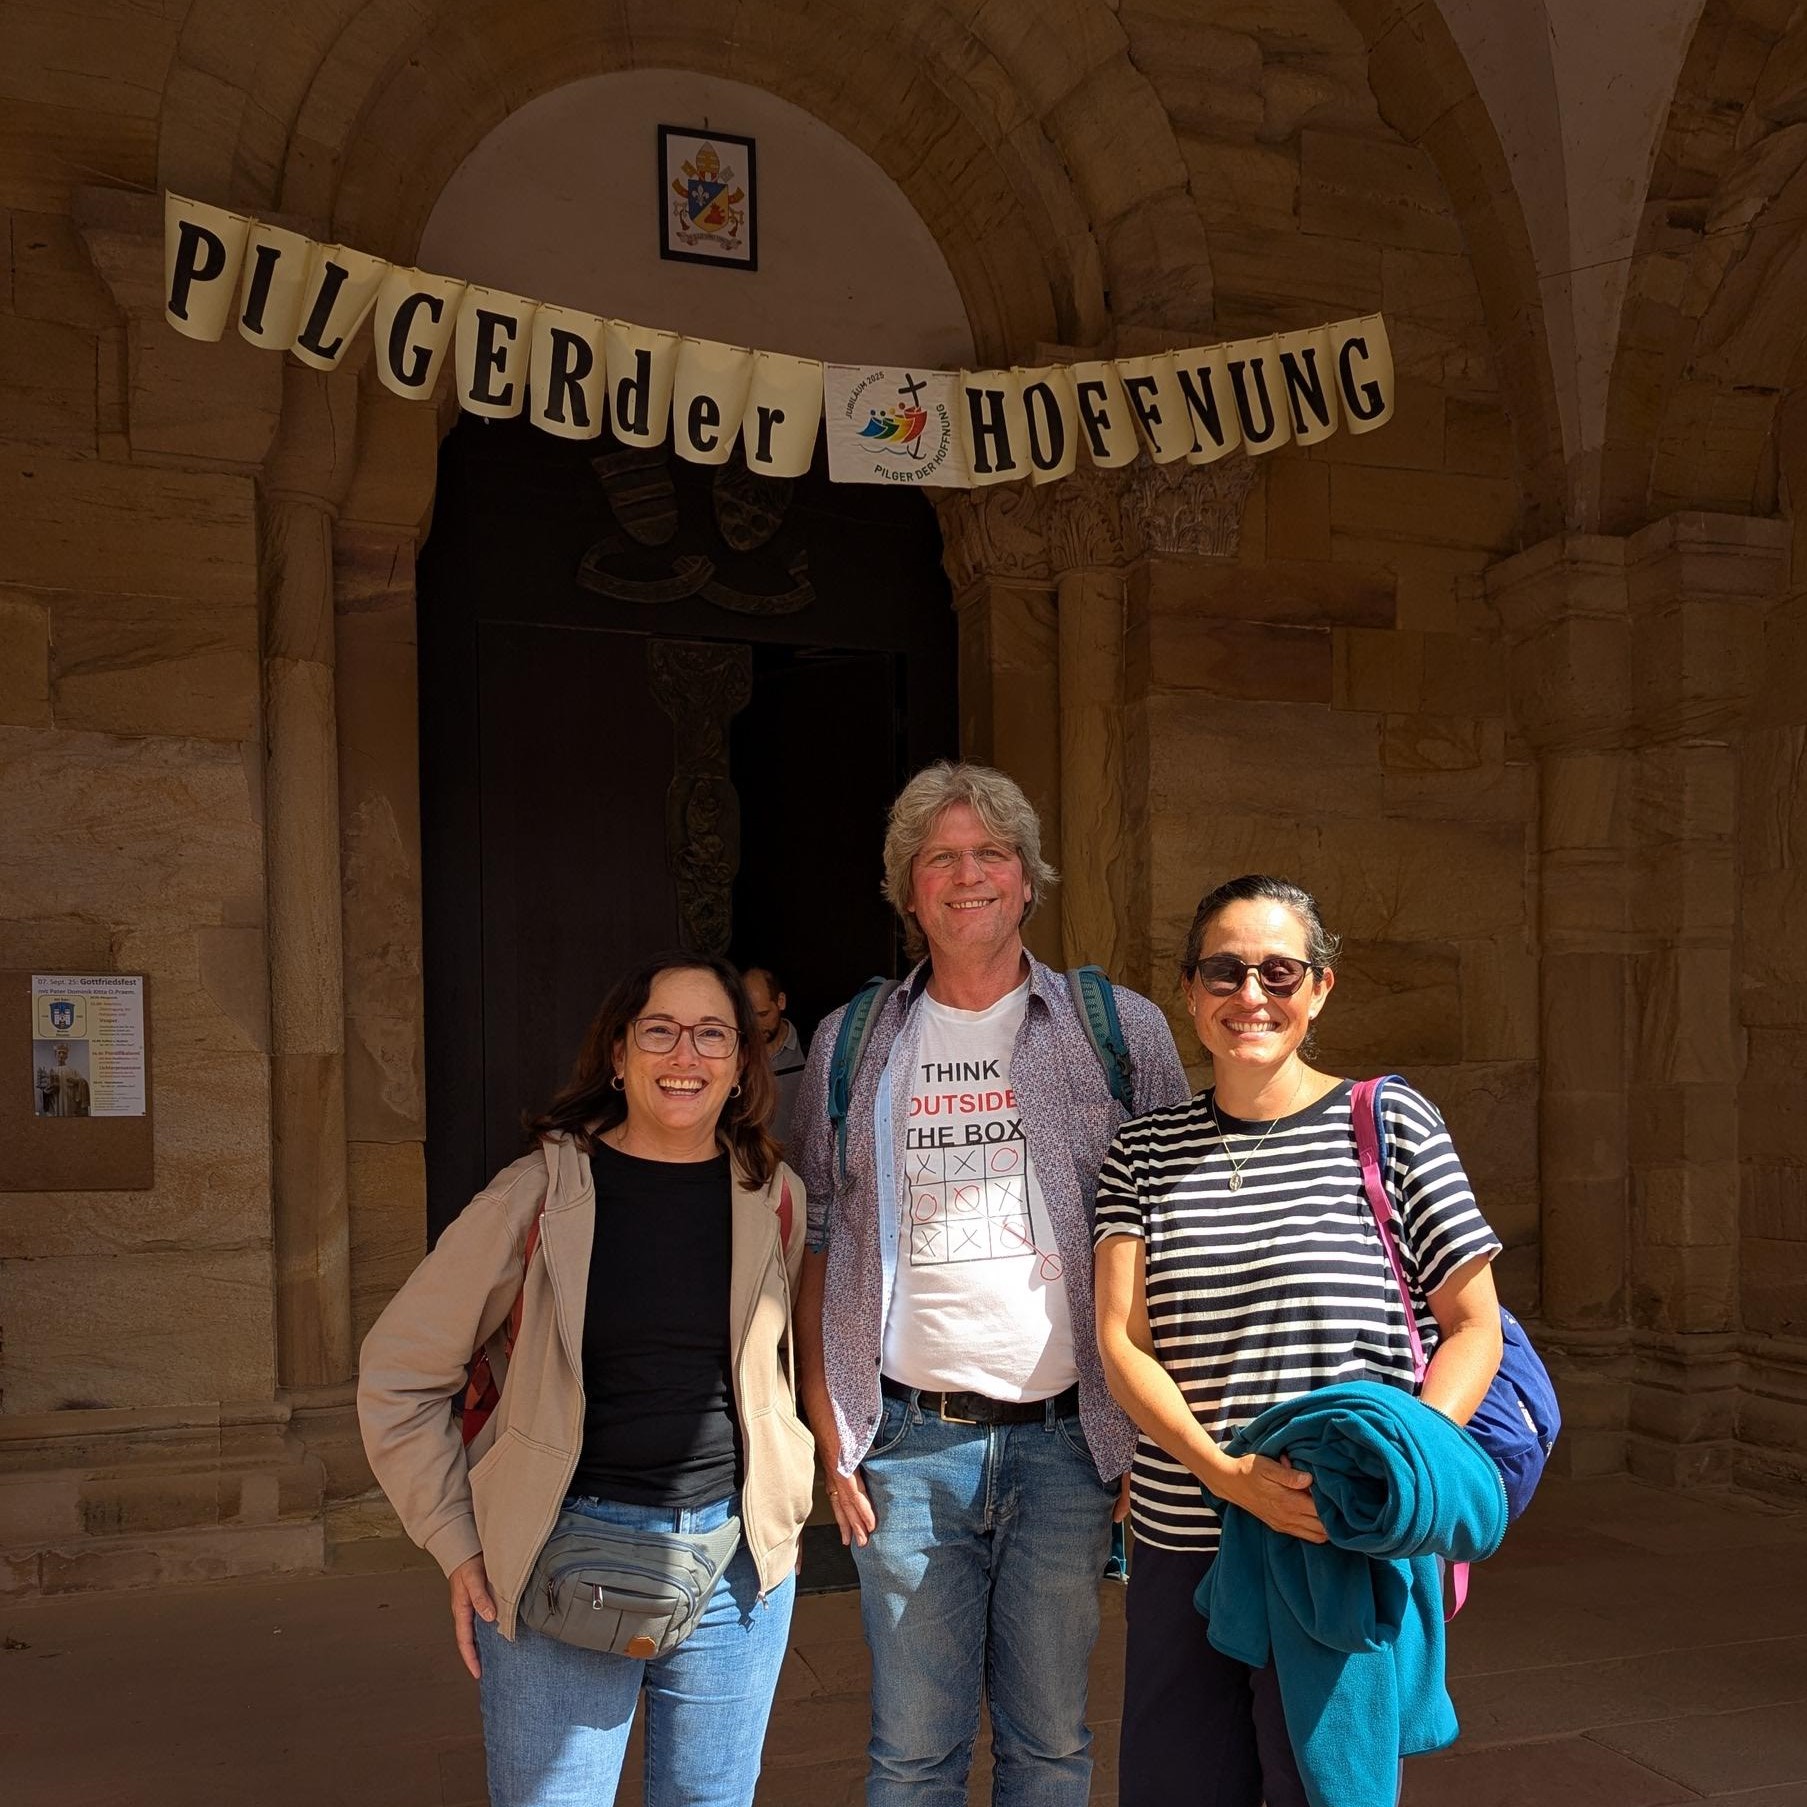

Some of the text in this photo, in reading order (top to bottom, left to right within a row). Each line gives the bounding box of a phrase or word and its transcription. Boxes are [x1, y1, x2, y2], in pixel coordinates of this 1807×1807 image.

[845, 371, 885, 419] JUBILÄUM 2025
[965, 337, 1386, 474] HOFFNUNG
[874, 403, 951, 481] PILGER DER HOFFNUNG
[80, 978, 137, 986] Gottfriedsfest
[921, 1059, 1000, 1083] THINK
[965, 1118, 1026, 1144] BOX
